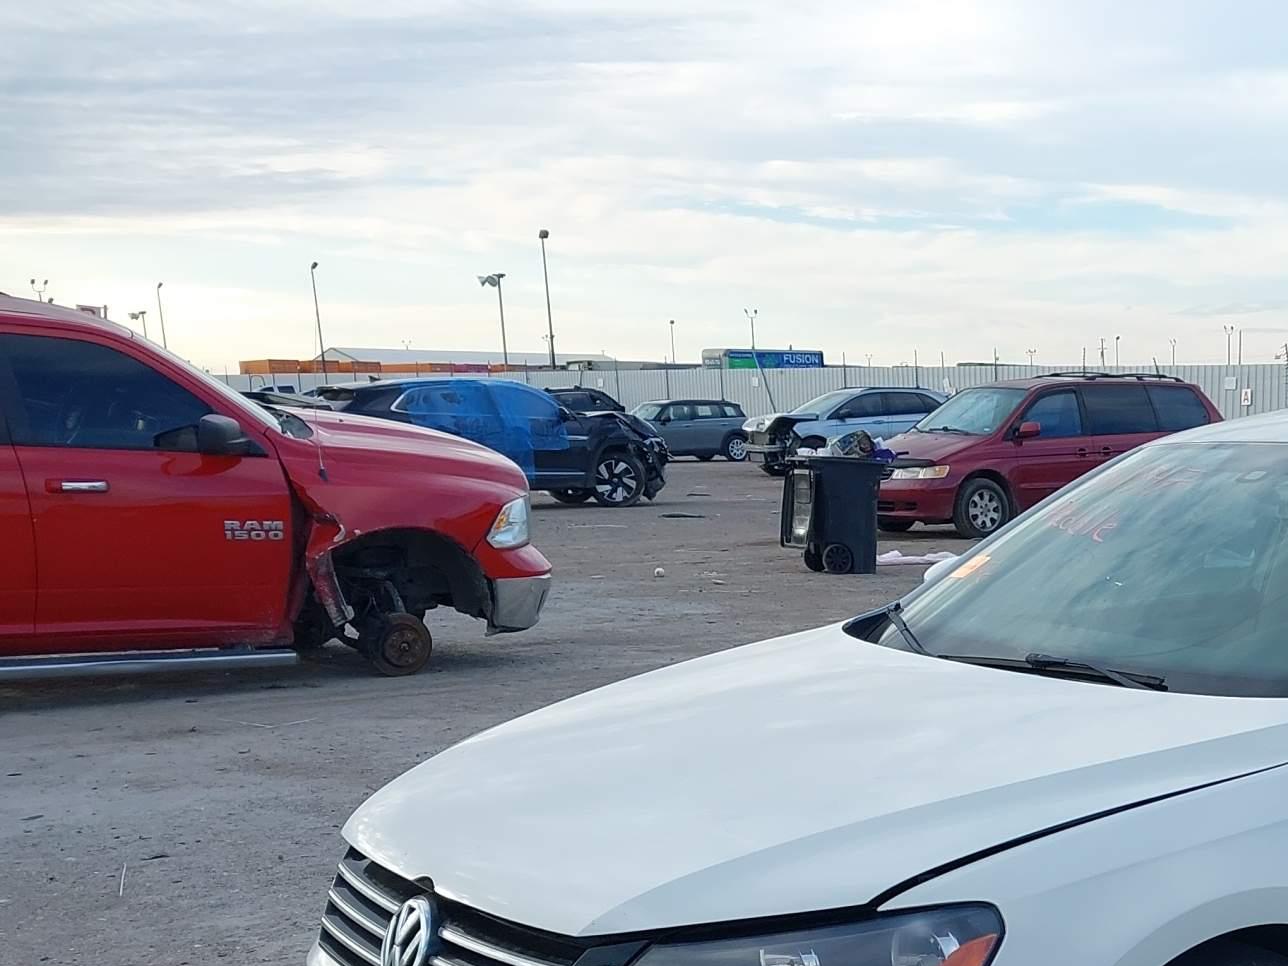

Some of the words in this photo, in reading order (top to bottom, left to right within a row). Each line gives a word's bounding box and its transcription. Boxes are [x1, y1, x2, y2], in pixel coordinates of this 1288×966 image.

[783, 353, 819, 365] FUSION
[1243, 390, 1250, 403] A
[223, 520, 284, 531] RAM
[224, 530, 284, 541] 1500
